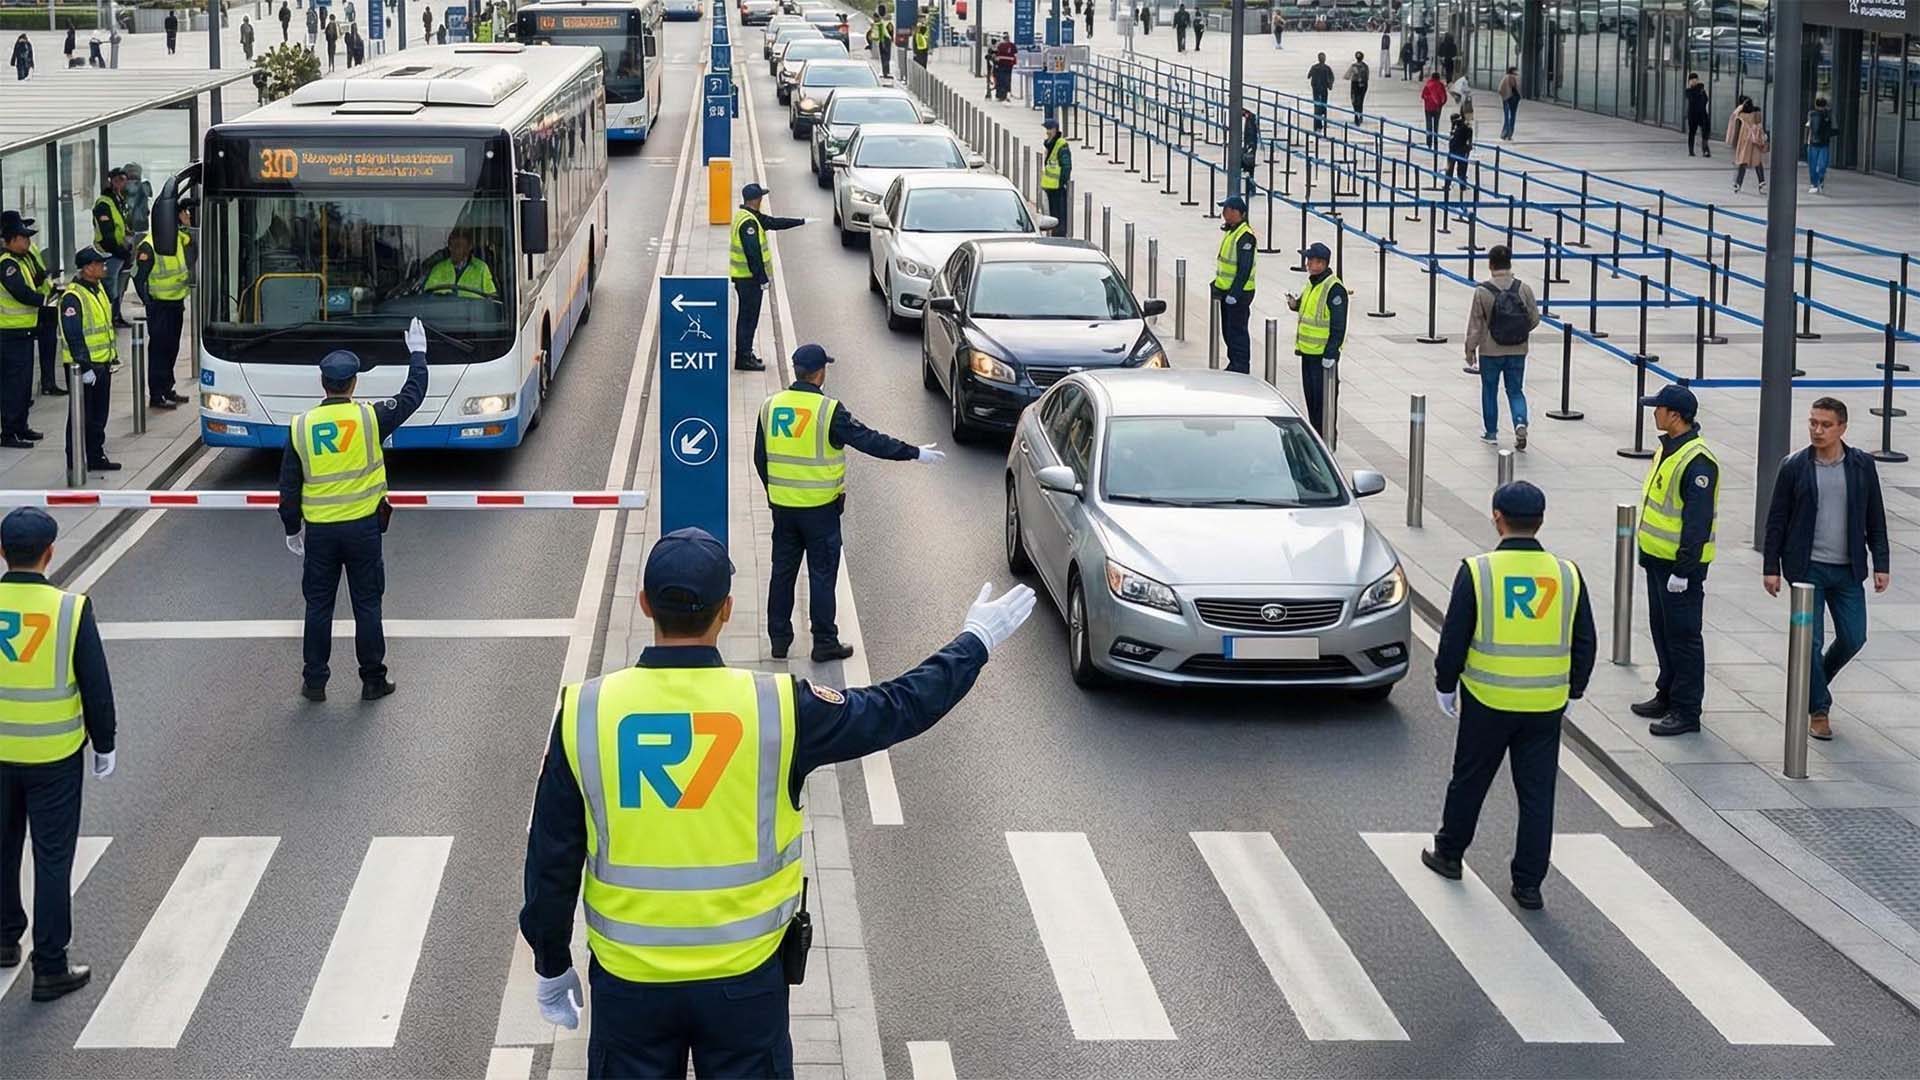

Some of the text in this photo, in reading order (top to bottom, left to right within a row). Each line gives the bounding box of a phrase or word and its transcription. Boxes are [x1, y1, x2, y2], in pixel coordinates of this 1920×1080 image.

[670, 351, 718, 370] EXIT
[312, 422, 355, 455] R7
[773, 408, 811, 438] R7
[1505, 577, 1557, 617] R7
[0, 612, 50, 662] R7
[618, 712, 743, 809] R7
